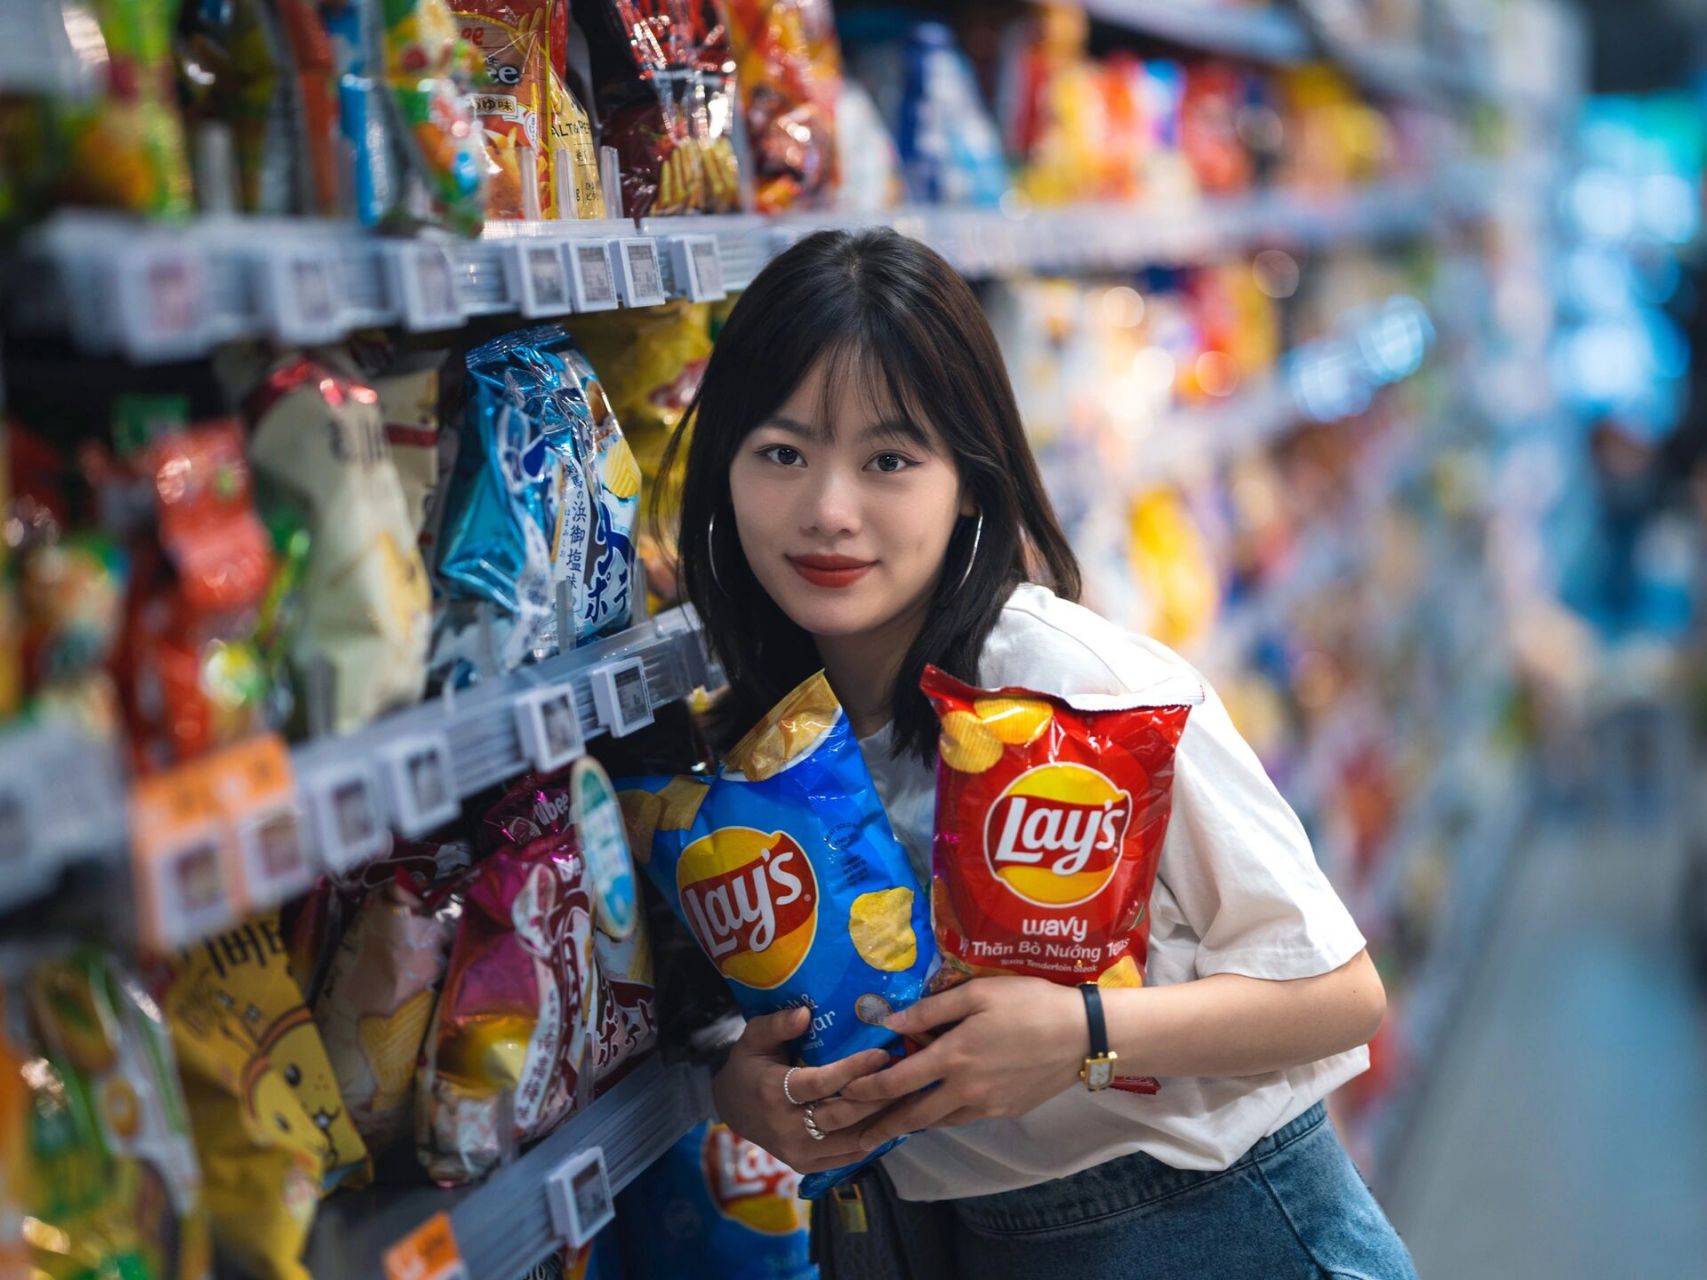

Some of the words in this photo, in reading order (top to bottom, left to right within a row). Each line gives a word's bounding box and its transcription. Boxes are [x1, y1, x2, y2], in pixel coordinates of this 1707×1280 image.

[994, 796, 1126, 876] Lay's
[685, 847, 803, 958] Lay's
[1022, 915, 1089, 943] wavy
[1018, 941, 1041, 956] Bò
